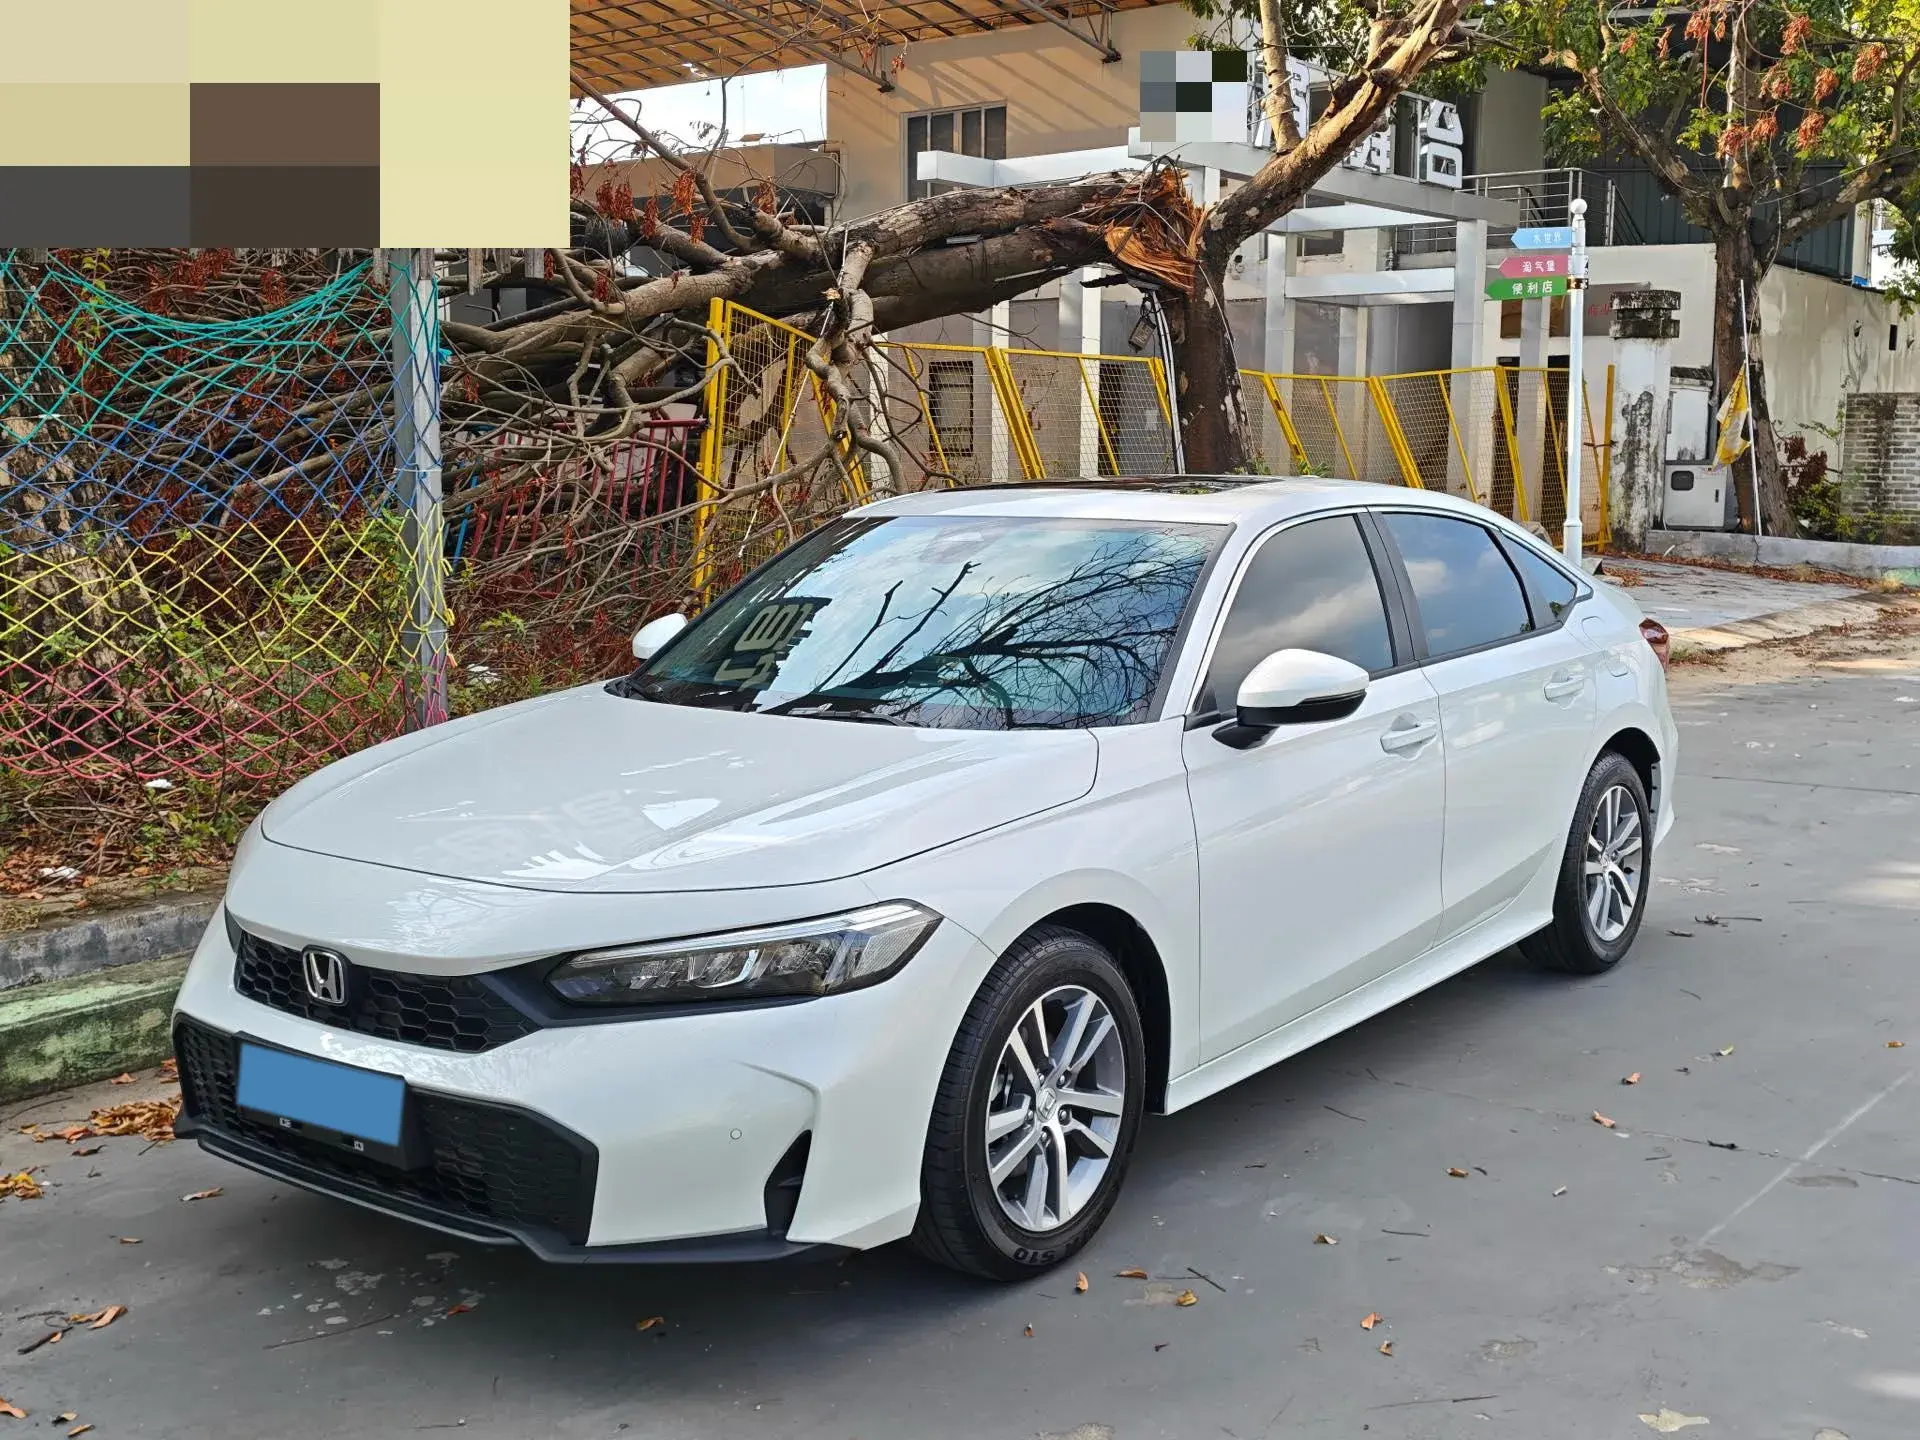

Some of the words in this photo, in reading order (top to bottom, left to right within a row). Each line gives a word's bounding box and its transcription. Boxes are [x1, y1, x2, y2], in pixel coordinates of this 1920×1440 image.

[1522, 260, 1555, 273] 淘气堡
[1512, 280, 1553, 295] 便利店
